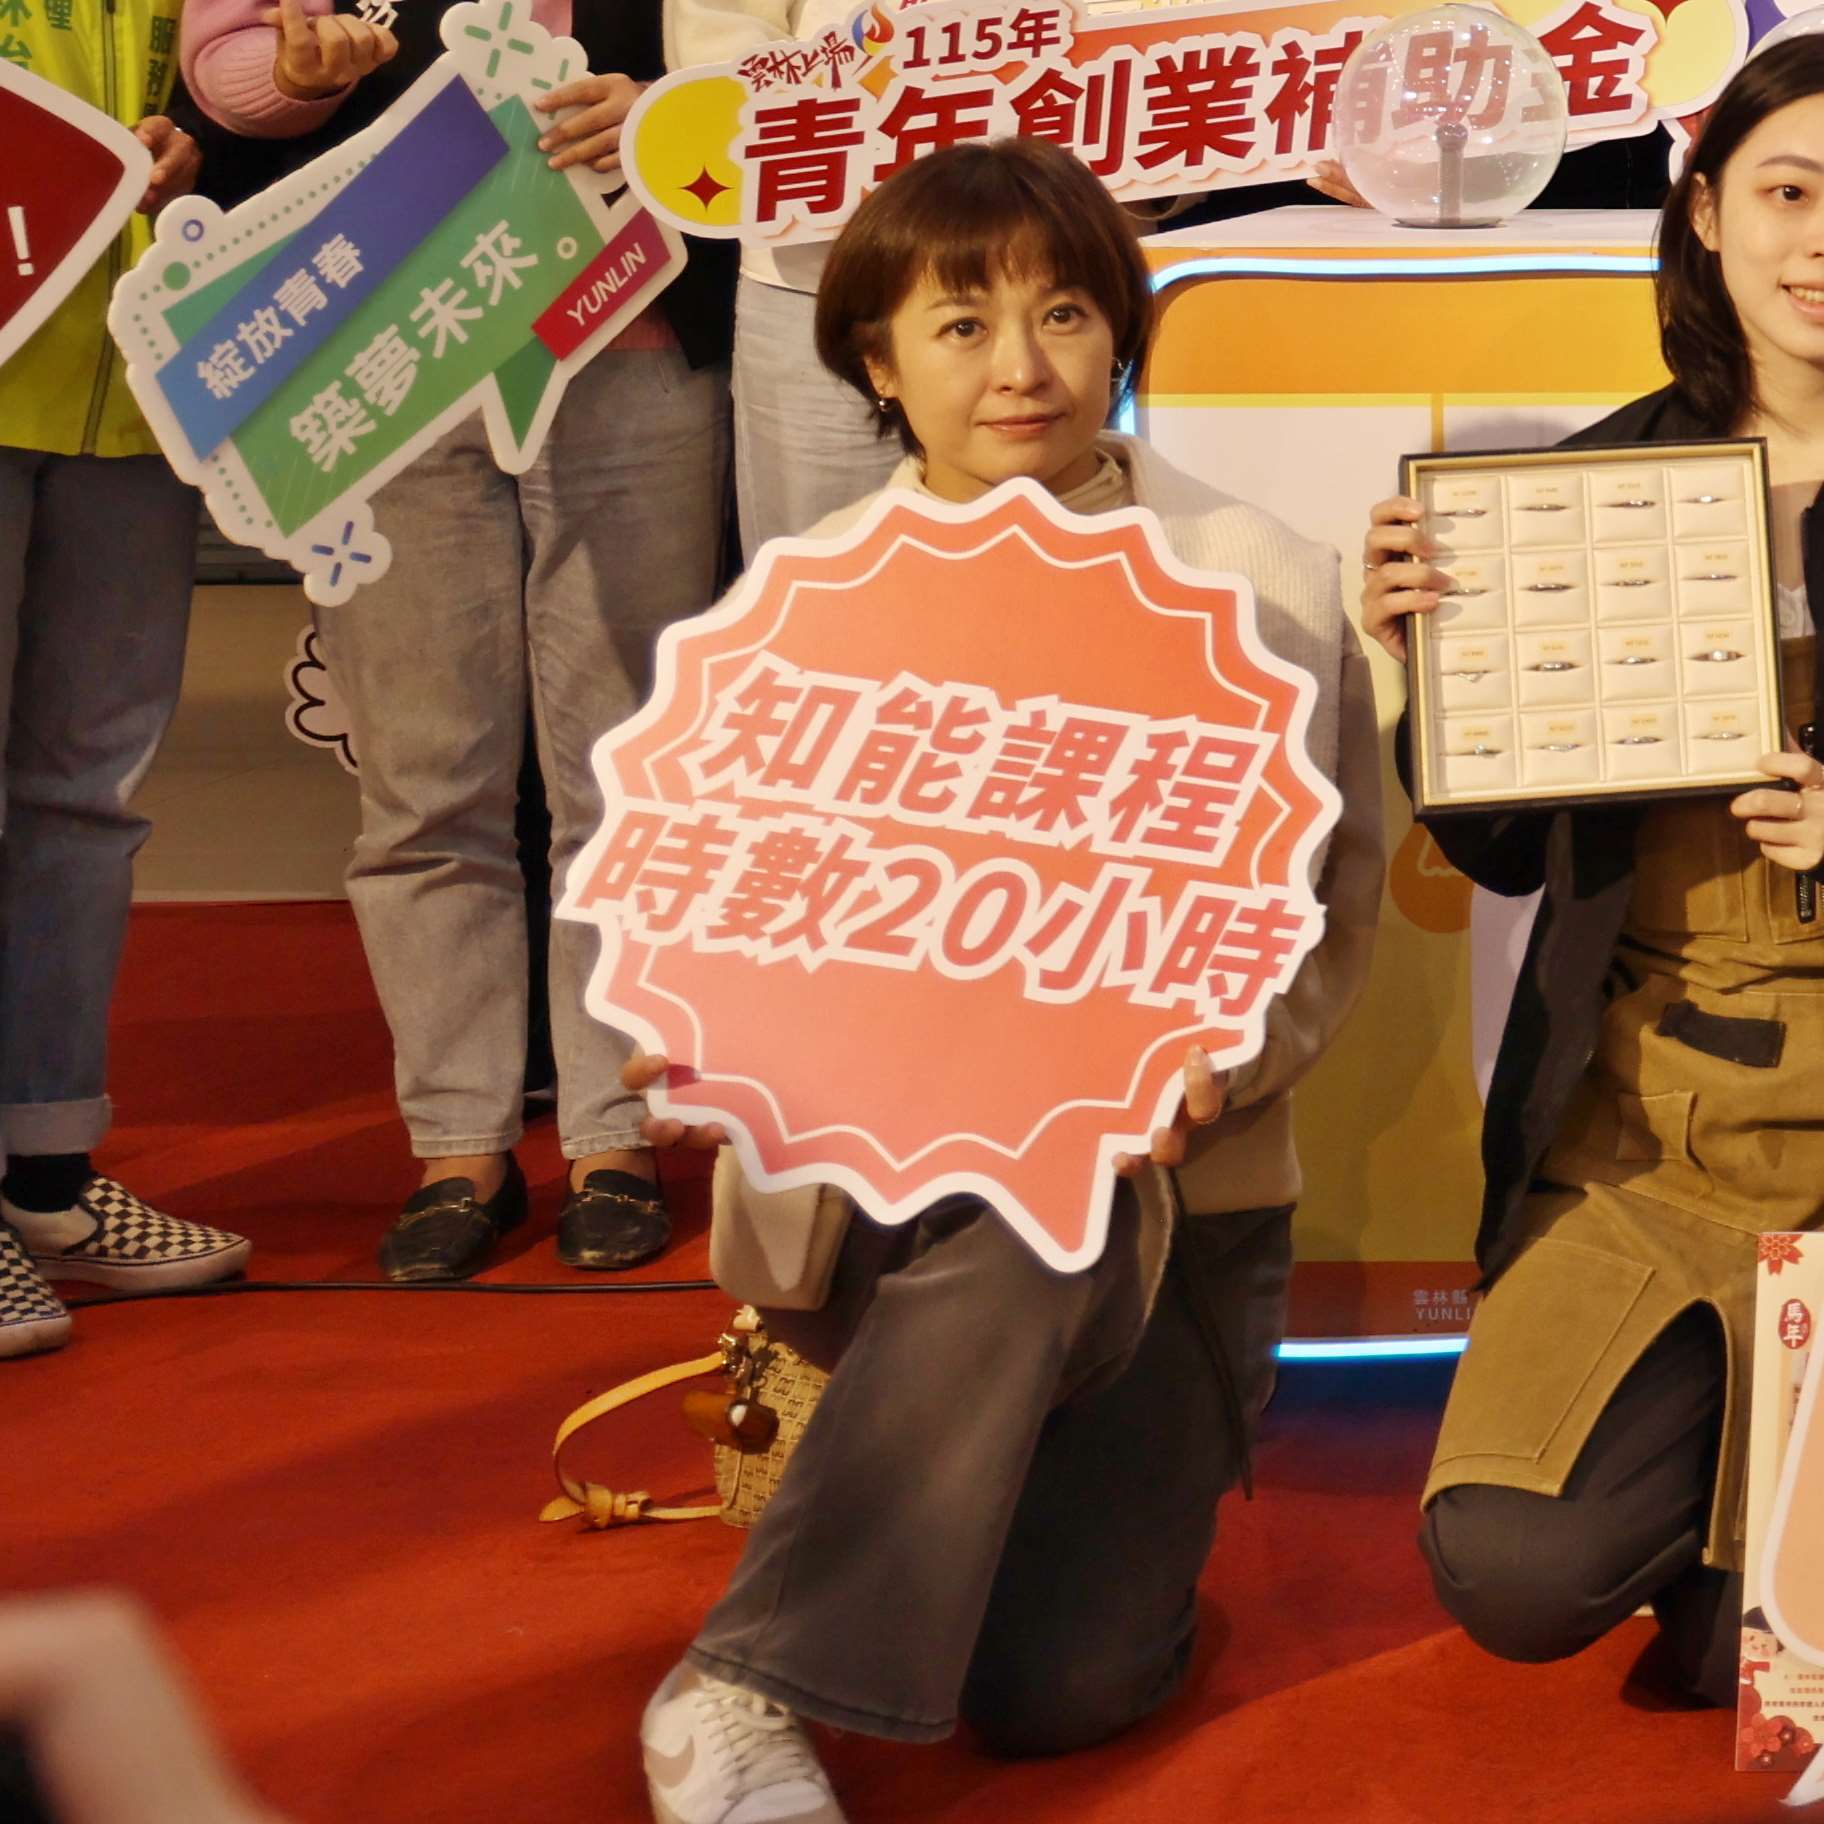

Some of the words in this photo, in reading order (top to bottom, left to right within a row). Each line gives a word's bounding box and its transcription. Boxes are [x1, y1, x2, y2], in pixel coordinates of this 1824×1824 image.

[742, 0, 1658, 224] 青年創業補助金
[903, 7, 1061, 69] 115年
[197, 232, 366, 402] 綻放青春
[566, 242, 647, 329] YUNLIN
[700, 669, 1264, 856] 知能課程
[580, 813, 1308, 1018] 時數20小時
